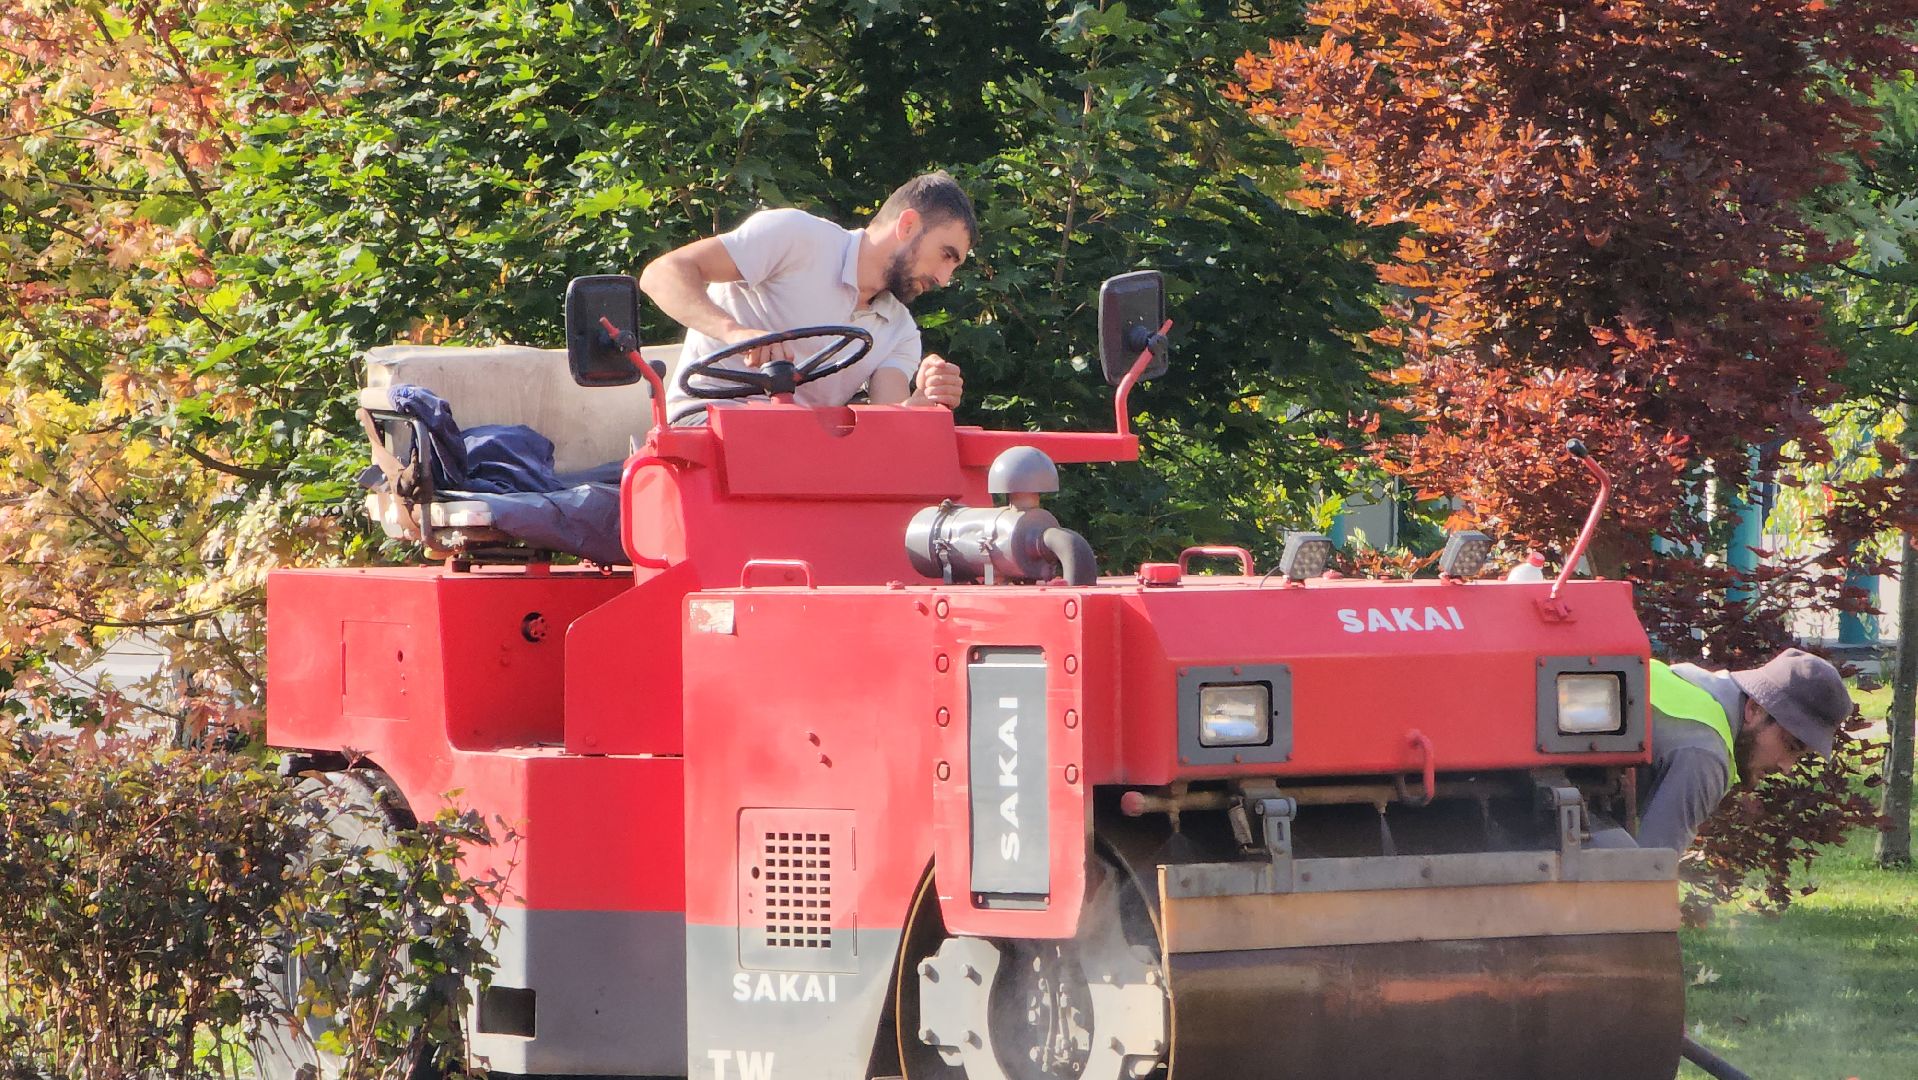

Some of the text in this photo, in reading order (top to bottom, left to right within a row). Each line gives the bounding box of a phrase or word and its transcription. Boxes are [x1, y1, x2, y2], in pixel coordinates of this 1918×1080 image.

[1337, 606, 1465, 633] SAKAI
[998, 697, 1020, 862] SAKAI
[733, 972, 836, 1003] SAKAI
[707, 1049, 775, 1080] TW
